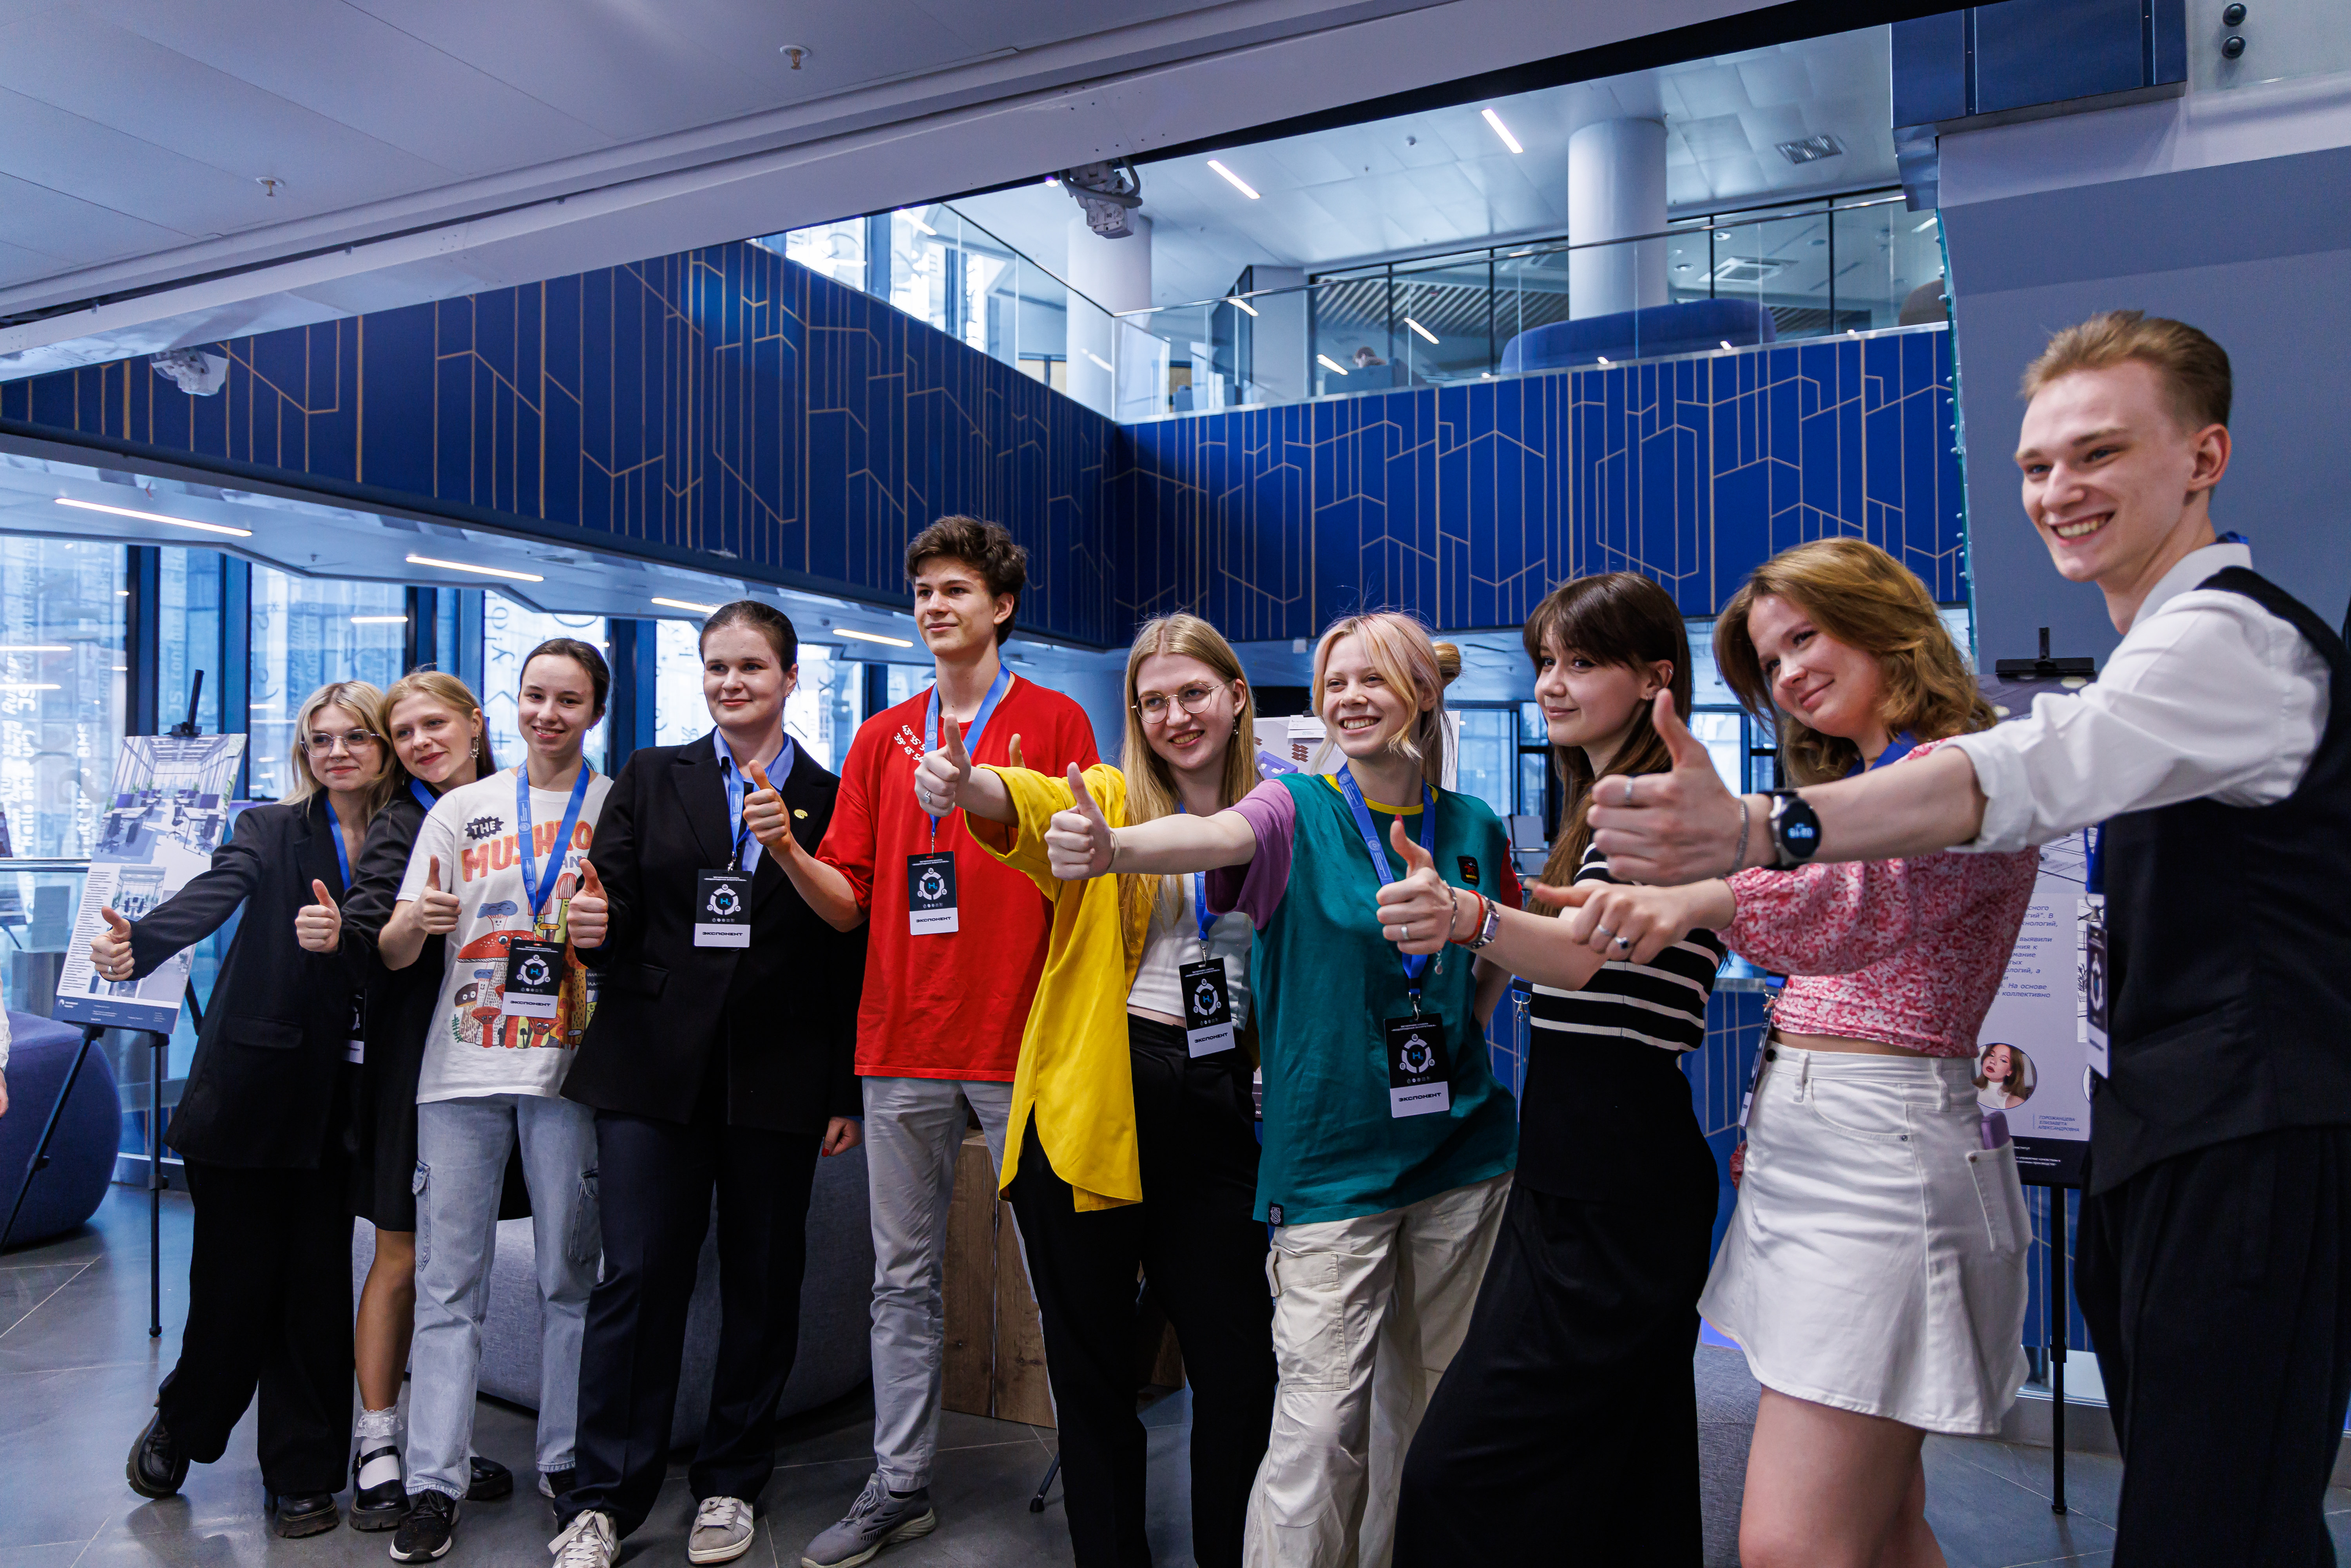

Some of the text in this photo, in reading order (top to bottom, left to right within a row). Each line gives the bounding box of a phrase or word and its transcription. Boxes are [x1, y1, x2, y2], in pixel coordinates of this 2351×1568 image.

[471, 820, 496, 835] THE
[461, 820, 596, 882] MUHO
[1194, 1032, 1228, 1043] ЭКСПОНЕНТ
[1398, 1092, 1442, 1102] ЭКСПОНЕНТ
